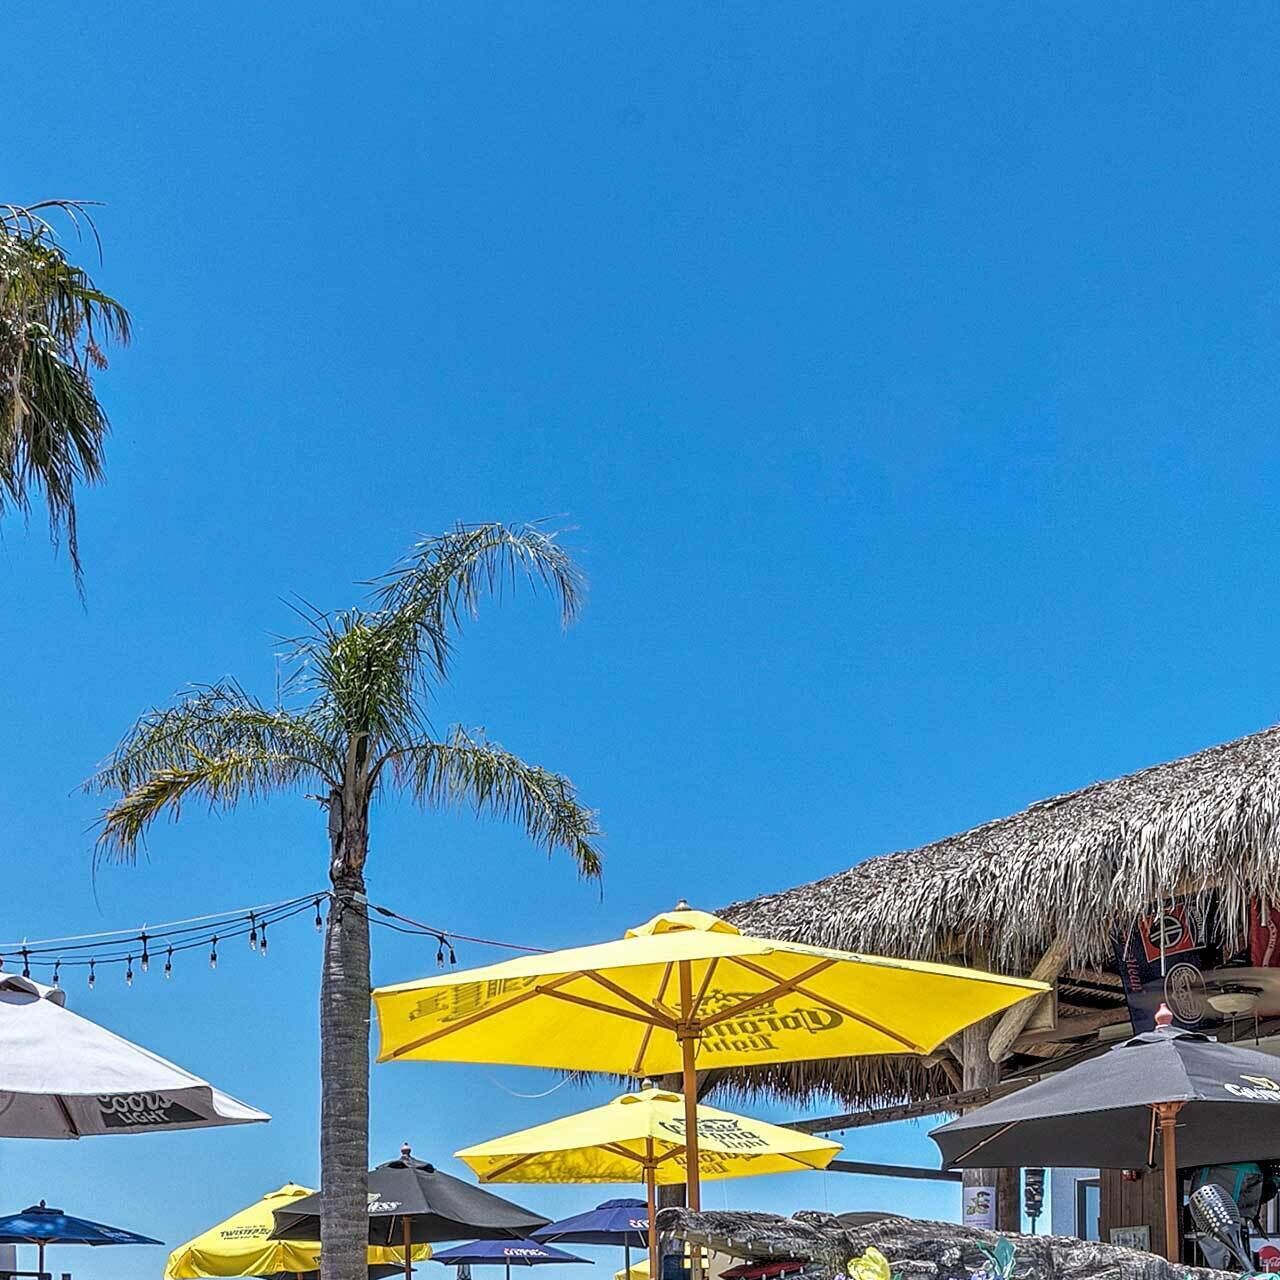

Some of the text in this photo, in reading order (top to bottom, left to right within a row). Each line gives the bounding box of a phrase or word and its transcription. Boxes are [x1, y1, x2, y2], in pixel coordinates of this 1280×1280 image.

[97, 1092, 173, 1113] Coors
[118, 1110, 170, 1124] LIGHT
[659, 1121, 761, 1141] Crona
